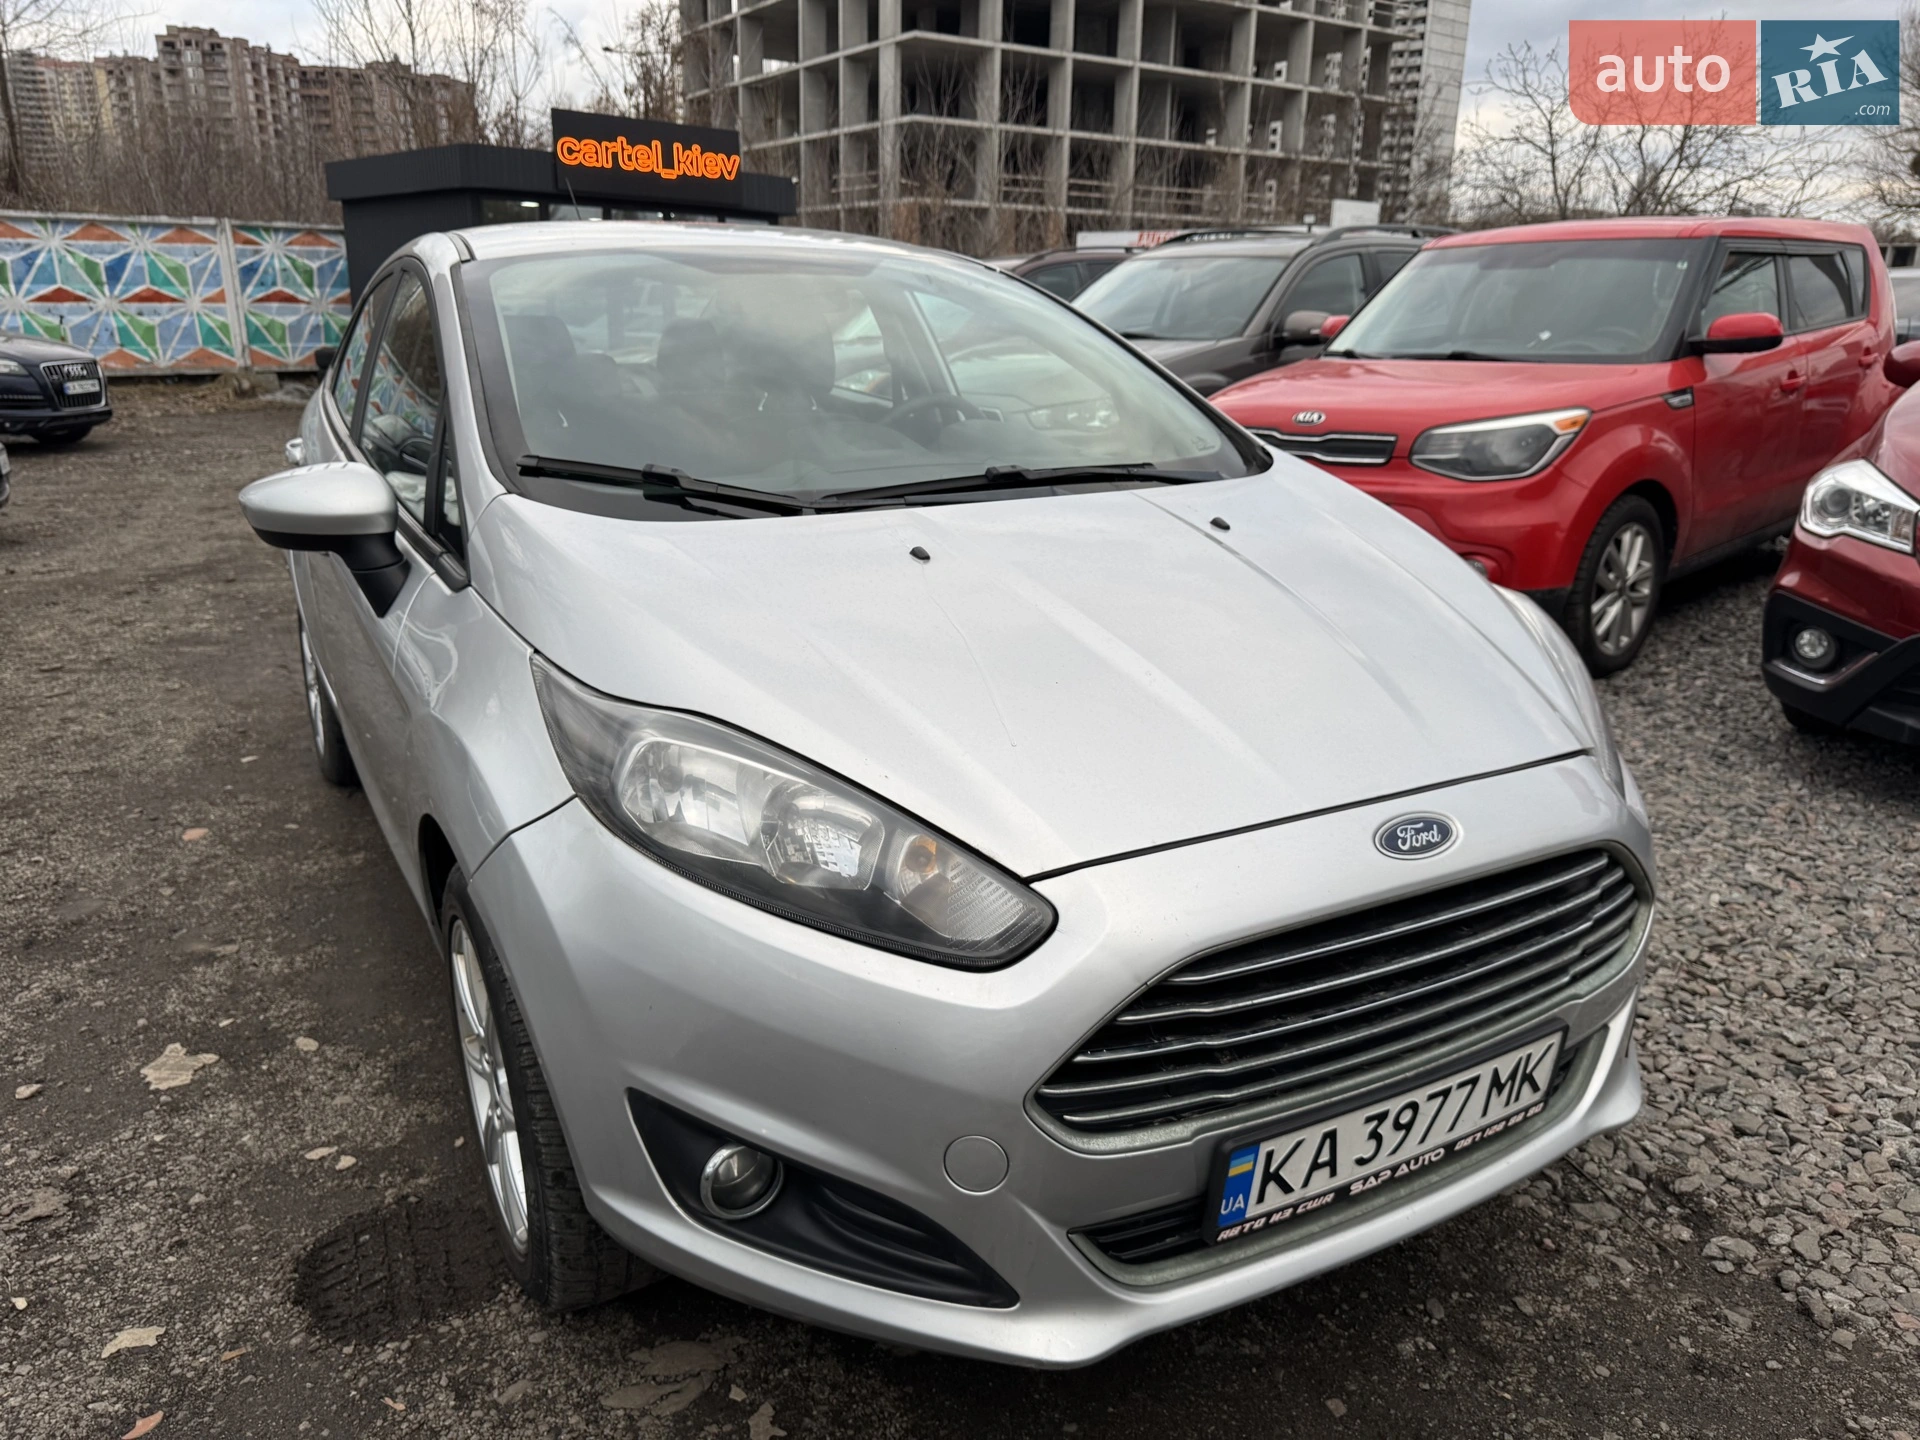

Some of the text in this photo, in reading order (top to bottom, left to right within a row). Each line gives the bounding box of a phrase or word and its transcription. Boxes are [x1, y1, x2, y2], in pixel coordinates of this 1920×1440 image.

[557, 136, 741, 181] cartel_kiev
[1396, 822, 1441, 850] Ford
[1255, 1041, 1554, 1205] KA 3977 MK
[1349, 1168, 1392, 1196] SAP
[1393, 1147, 1446, 1178] AUTO
[1220, 1193, 1245, 1215] UA
